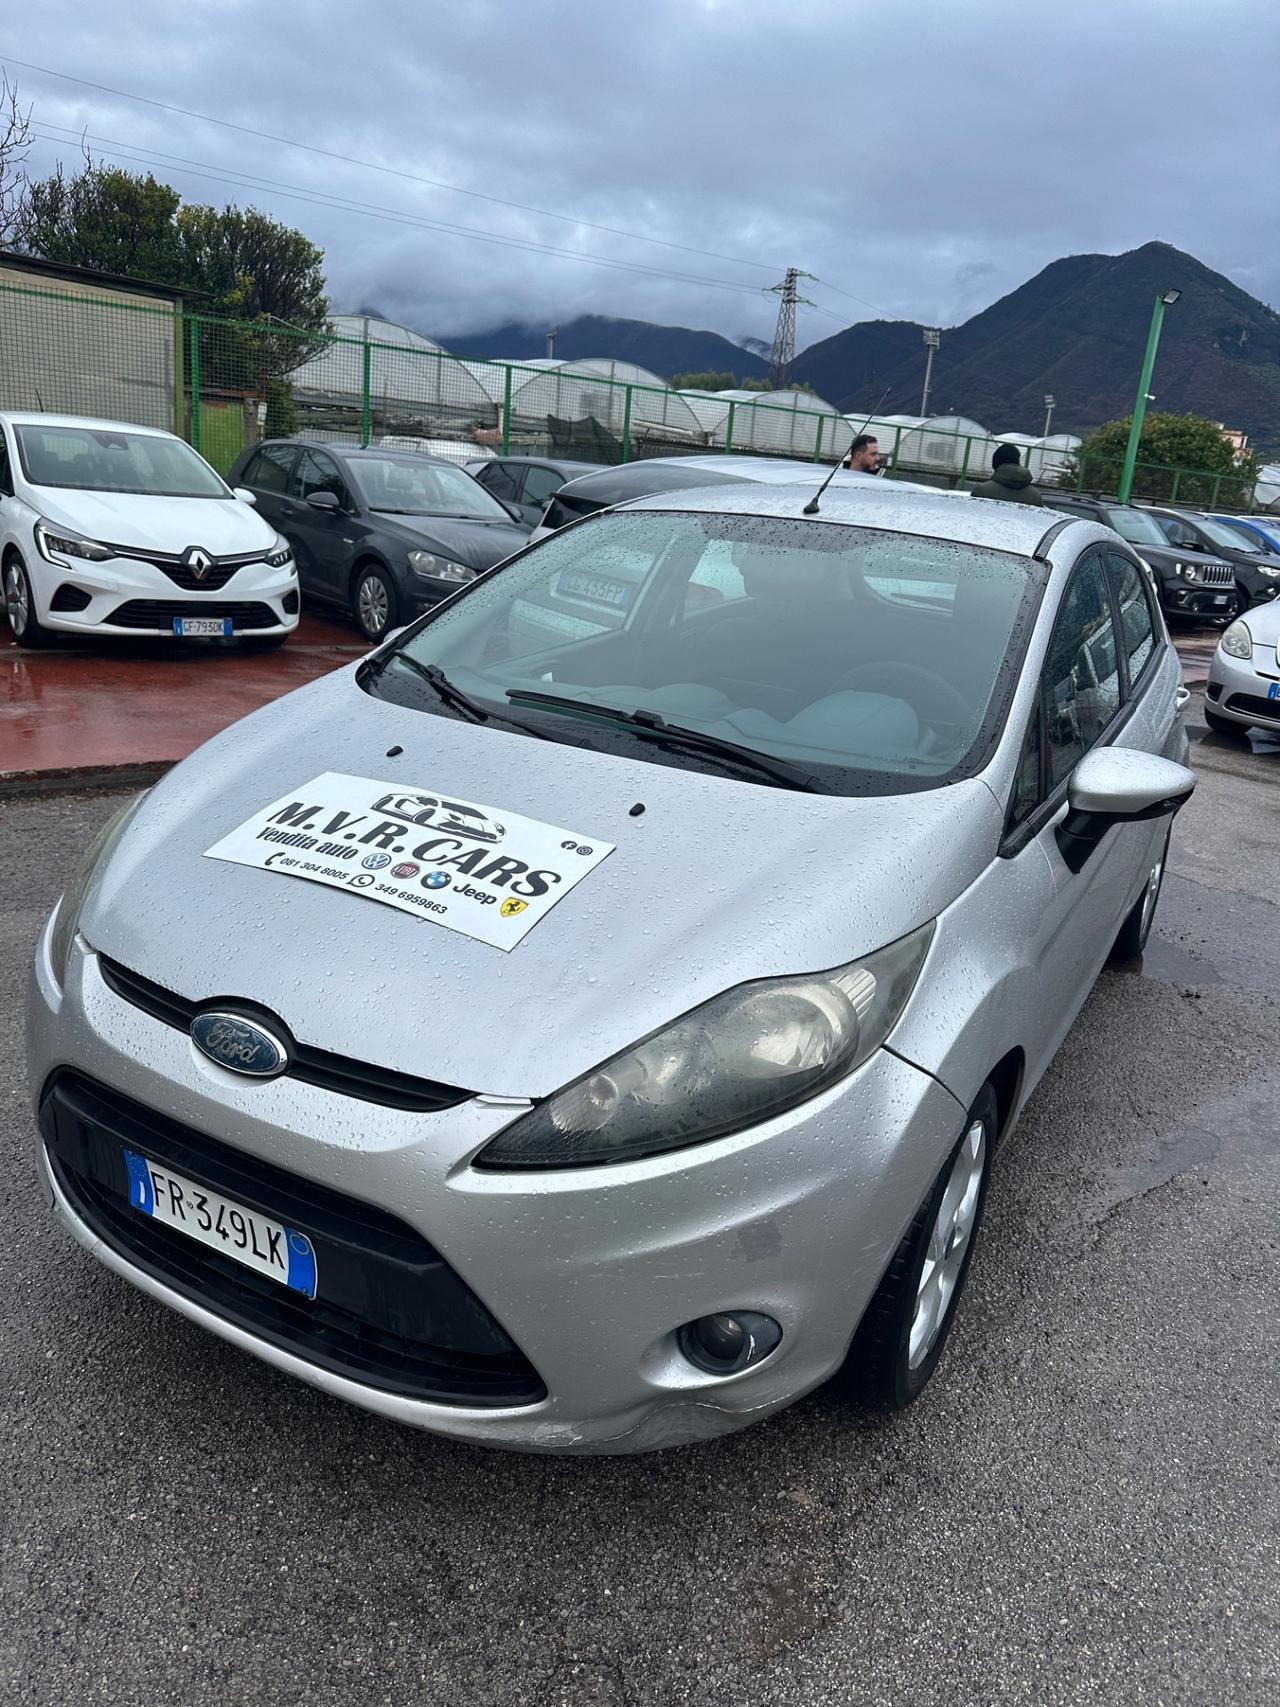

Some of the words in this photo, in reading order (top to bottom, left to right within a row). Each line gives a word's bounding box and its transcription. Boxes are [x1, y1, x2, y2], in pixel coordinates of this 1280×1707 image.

[256, 826, 319, 850] Vendita
[315, 840, 359, 860] auto
[280, 857, 299, 869] 081
[299, 861, 319, 873] 304
[320, 867, 350, 881] 8005
[374, 883, 398, 896] 349
[397, 891, 448, 915] 6959863
[452, 883, 498, 906] Jeep
[206, 1021, 261, 1064] Ford
